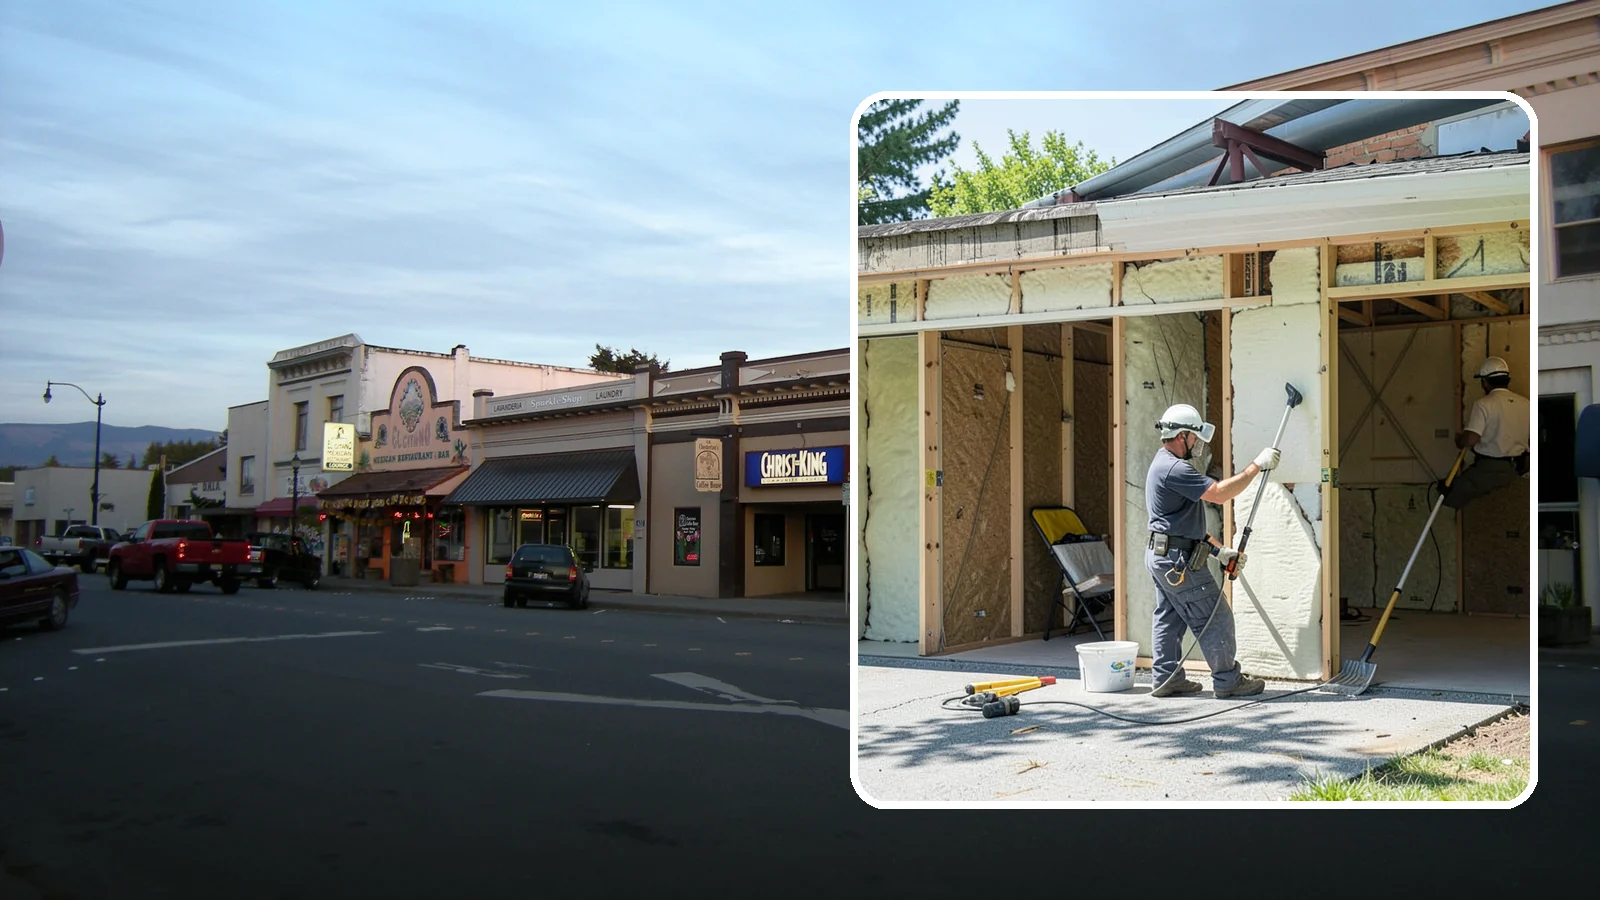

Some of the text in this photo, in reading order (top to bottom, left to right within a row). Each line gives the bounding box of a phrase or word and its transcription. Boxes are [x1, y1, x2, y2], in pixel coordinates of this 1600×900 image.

[493, 389, 624, 413] LAVANDERIA Sparkle Shop LAUNDRY
[398, 451, 433, 462] RESTAURANT
[438, 450, 450, 459] BAR
[799, 450, 827, 476] KING
